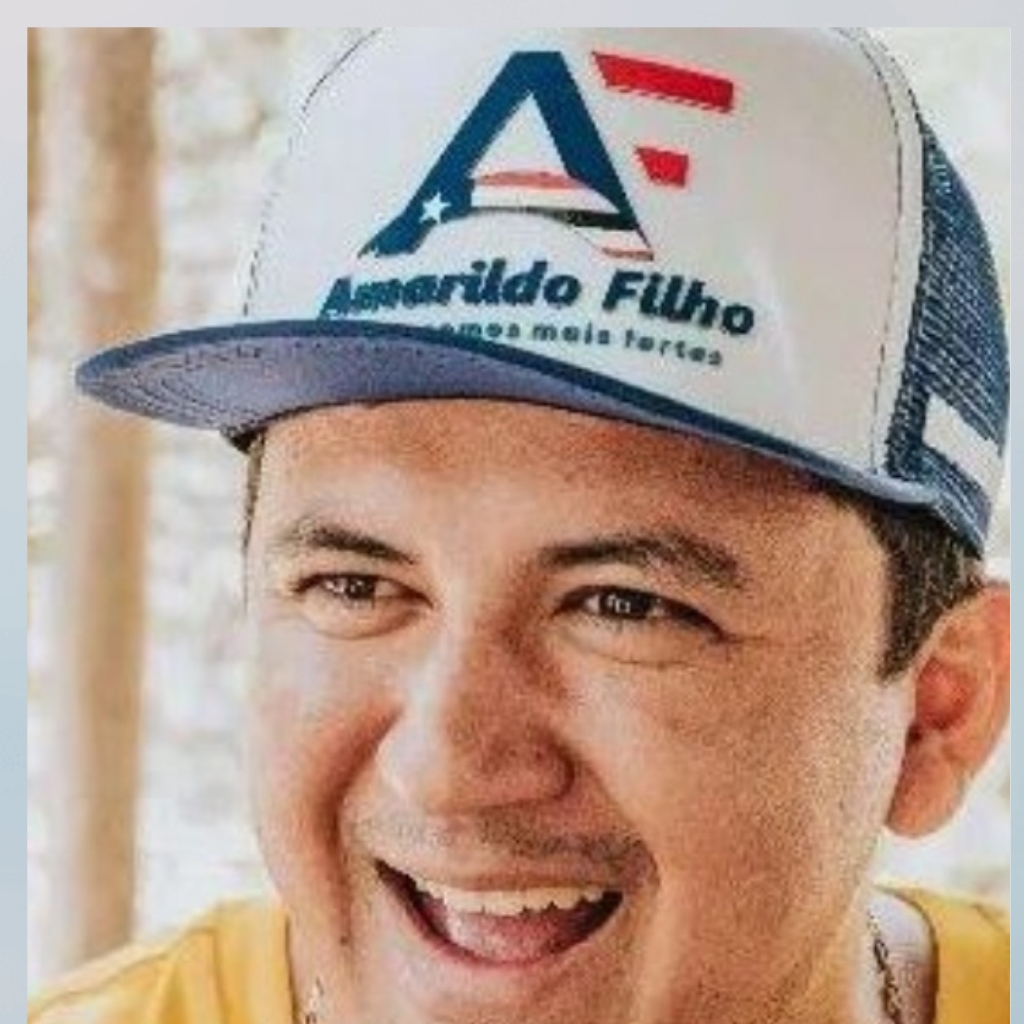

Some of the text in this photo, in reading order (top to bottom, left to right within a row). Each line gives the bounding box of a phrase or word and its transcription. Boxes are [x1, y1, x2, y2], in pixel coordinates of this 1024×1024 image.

[317, 258, 754, 335] Amarildo Filho
[532, 324, 610, 345] mais
[625, 329, 722, 366] fortes
